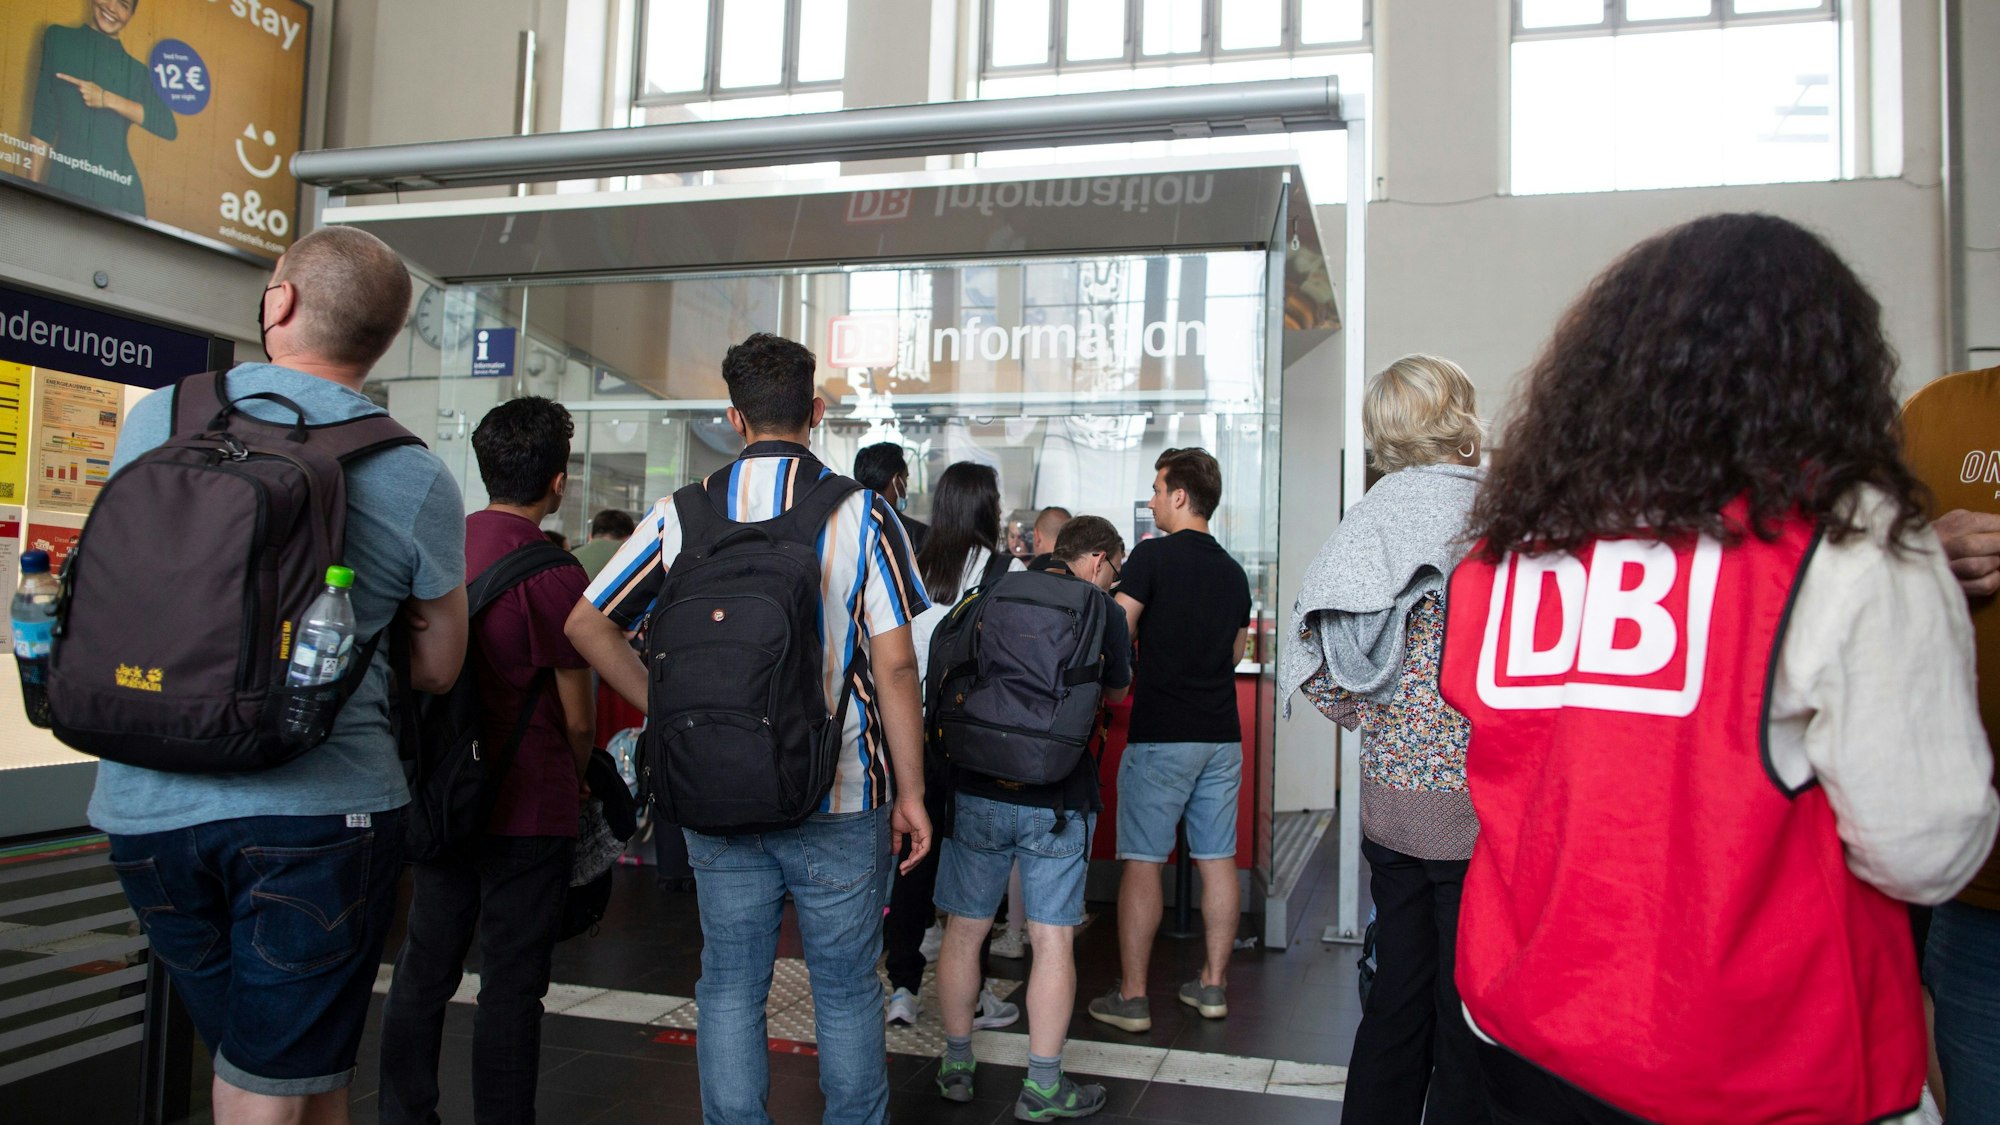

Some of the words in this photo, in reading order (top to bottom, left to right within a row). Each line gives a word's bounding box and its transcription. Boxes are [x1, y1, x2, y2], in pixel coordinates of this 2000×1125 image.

[229, 0, 301, 51] stay
[154, 63, 184, 90] 12
[185, 66, 206, 92] €
[23, 157, 32, 169] 2
[49, 147, 133, 186] hauptbahnhof
[220, 189, 289, 238] a&o
[837, 324, 890, 360] DB
[914, 315, 1207, 363] nformaton
[46, 378, 92, 391] ENERGIEAUSWEIS
[1506, 539, 1678, 678] DB
